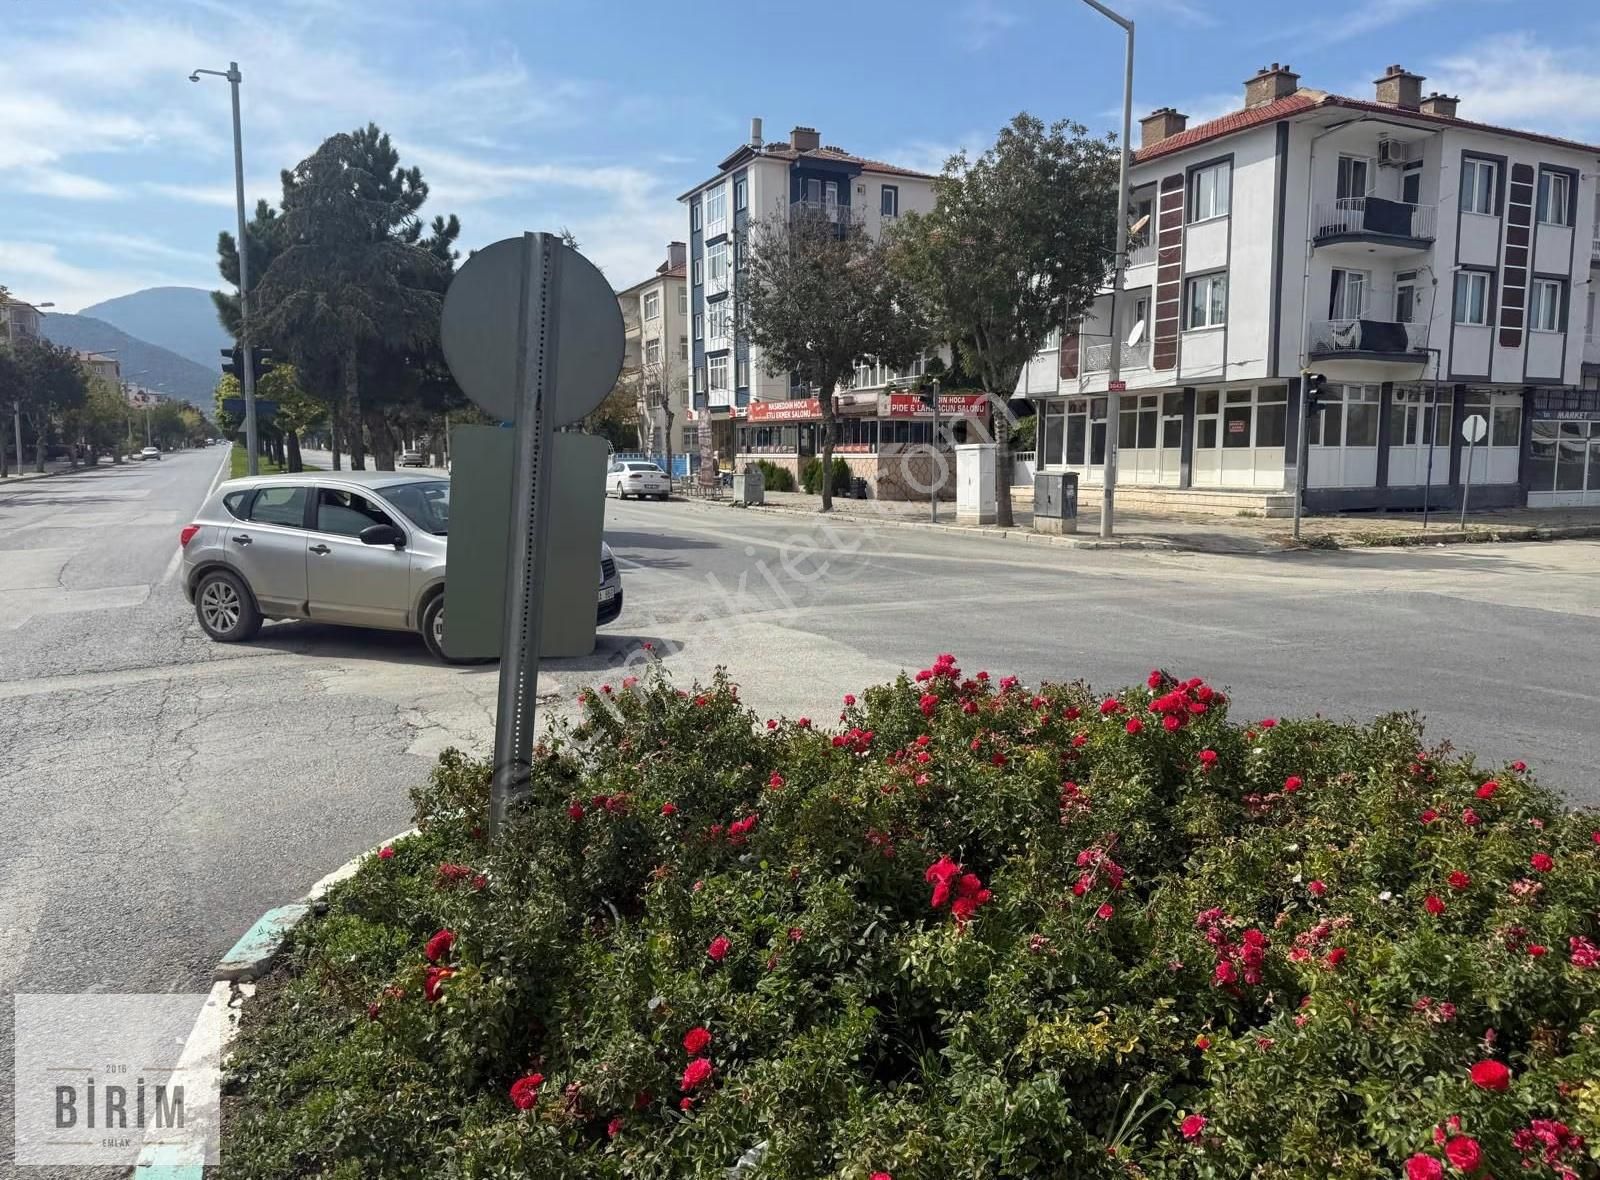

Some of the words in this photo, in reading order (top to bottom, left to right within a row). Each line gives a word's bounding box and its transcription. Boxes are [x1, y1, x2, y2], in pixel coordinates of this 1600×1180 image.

[949, 396, 966, 404] HOCA
[793, 400, 808, 409] HOCA
[957, 404, 984, 412] SALONU
[776, 411, 791, 419] EKMEK
[791, 410, 811, 418] SALONU
[1557, 411, 1588, 419] MARKET
